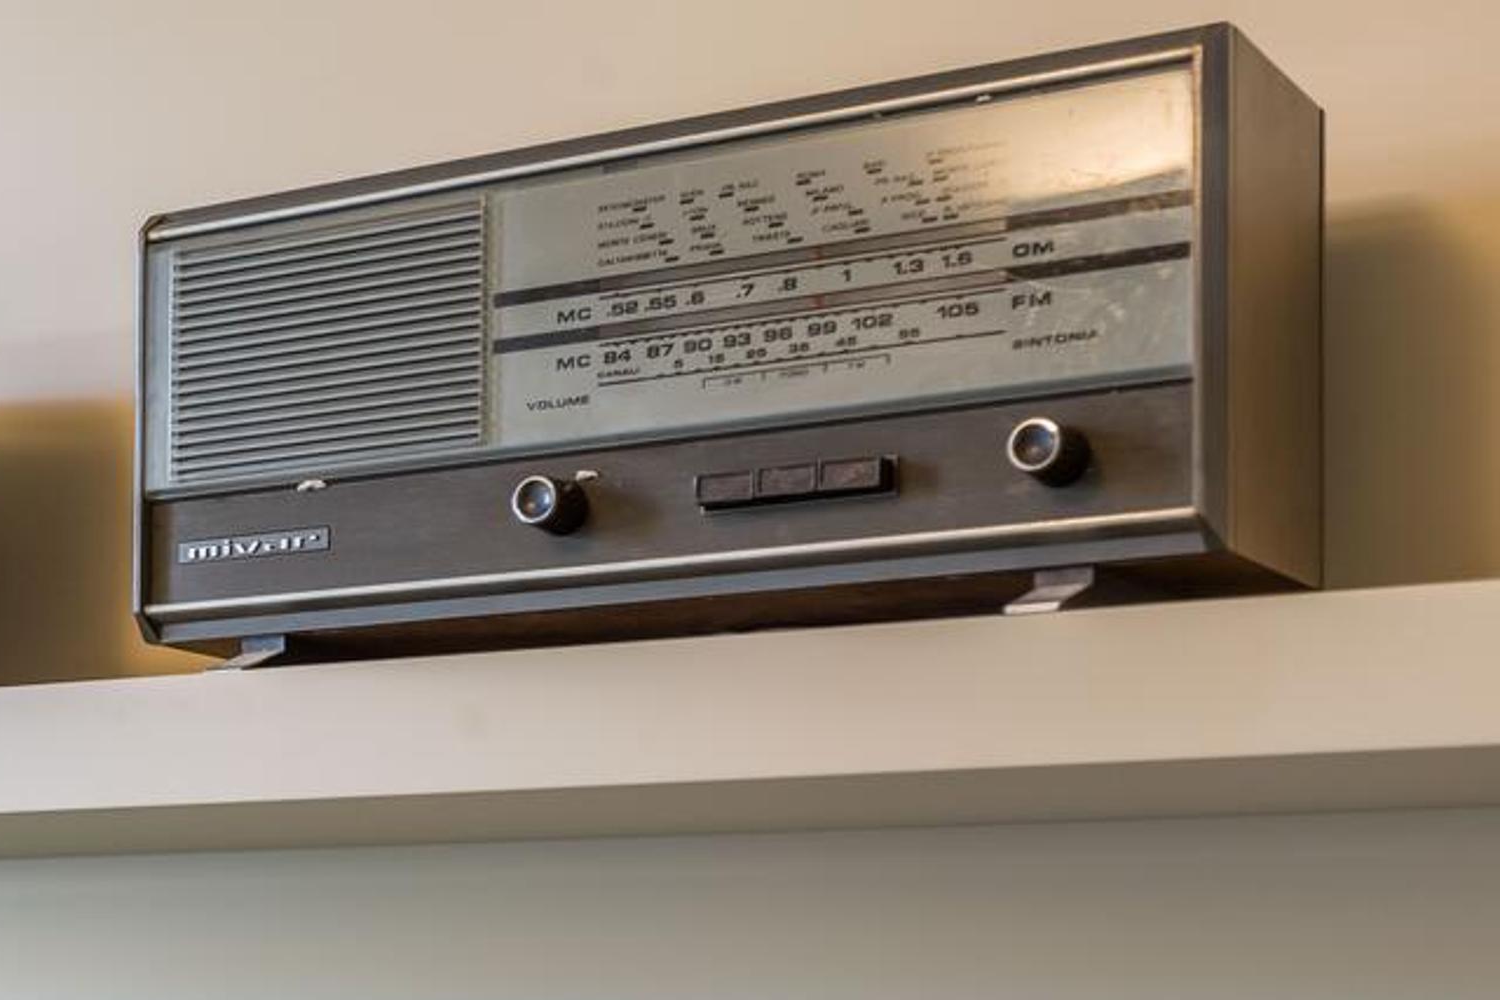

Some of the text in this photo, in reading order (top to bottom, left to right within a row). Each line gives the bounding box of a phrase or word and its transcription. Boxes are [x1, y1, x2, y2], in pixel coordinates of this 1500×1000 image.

[556, 308, 592, 325] MC
[644, 295, 677, 312] .55
[684, 291, 705, 306] .6
[736, 283, 755, 299] .7
[778, 277, 798, 292] .8
[842, 269, 852, 283] 1
[892, 259, 925, 276] 1.3
[1012, 241, 1055, 259] OM
[556, 355, 592, 372] MC
[603, 350, 631, 365] 84
[646, 344, 674, 359] 87
[683, 339, 713, 354] 90
[723, 333, 752, 348] 93
[807, 321, 838, 337] 99
[850, 314, 894, 331] 102
[937, 302, 980, 319] 105
[1011, 291, 1052, 310] FM
[1012, 330, 1098, 351] SINTONIA
[526, 394, 592, 412] VOLUME
[188, 534, 320, 559] mivar
